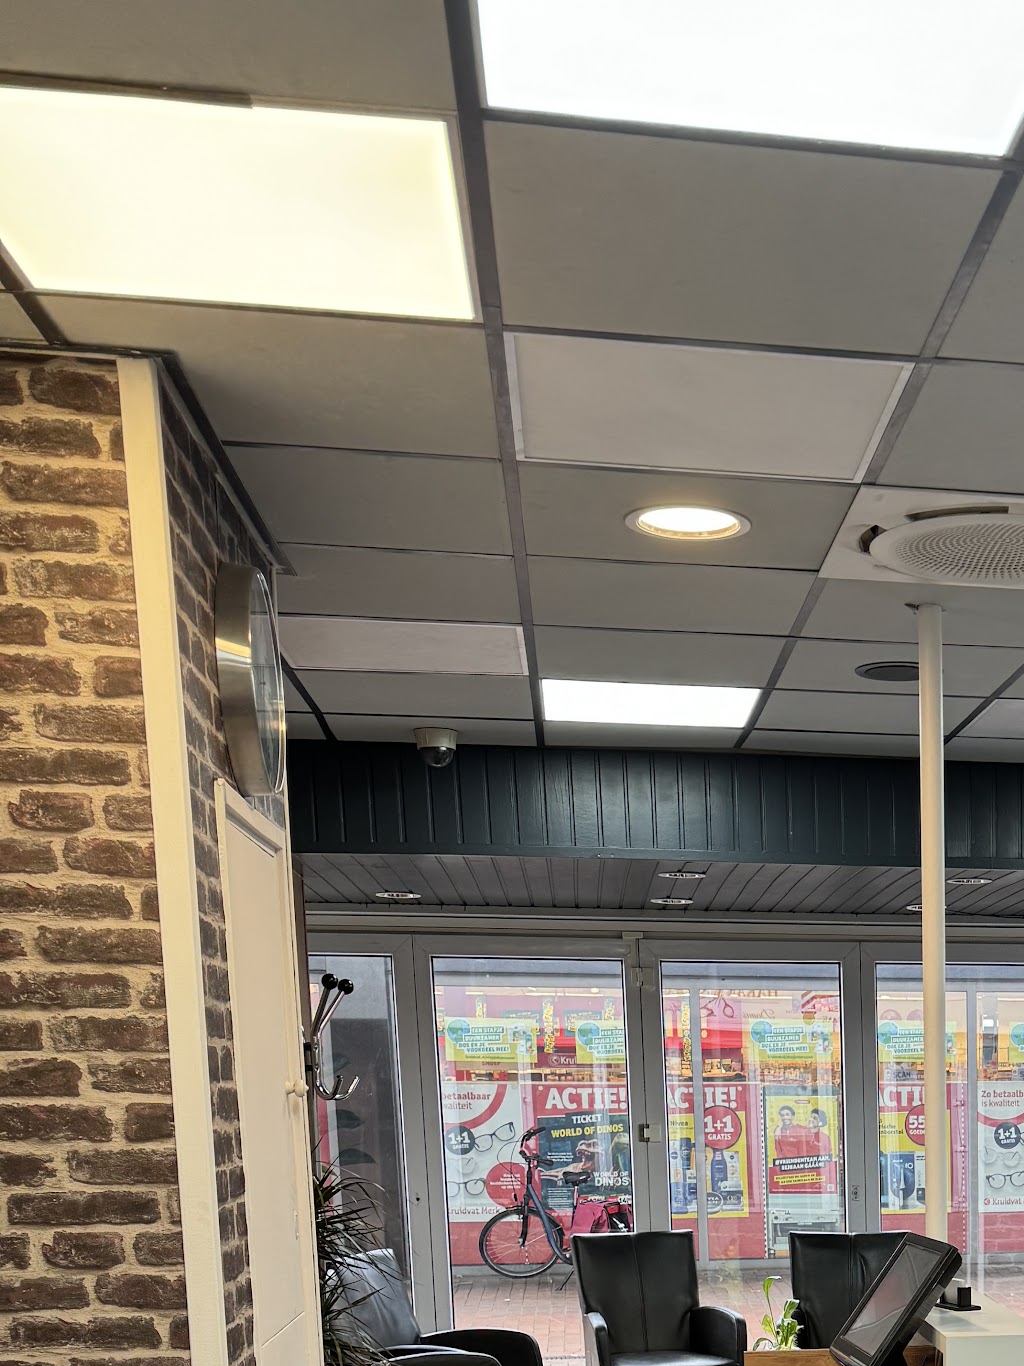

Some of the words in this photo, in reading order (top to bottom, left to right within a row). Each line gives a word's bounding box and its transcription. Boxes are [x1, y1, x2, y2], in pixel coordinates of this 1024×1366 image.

[545, 1087, 627, 1110] ACTIE!
[981, 1090, 992, 1098] Zo
[989, 1099, 1020, 1107] kwaliteit
[572, 1114, 602, 1124] TICKET
[704, 1115, 734, 1133] 1+1
[551, 1128, 582, 1138] WORLD
[584, 1126, 595, 1135] OF
[597, 1124, 624, 1133] DINOS
[998, 1127, 1017, 1140] 1+1
[448, 1131, 471, 1145] 1+1
[708, 1133, 732, 1141] GRATIS
[595, 1177, 630, 1187] DINOS
[482, 1206, 500, 1215] Merk
